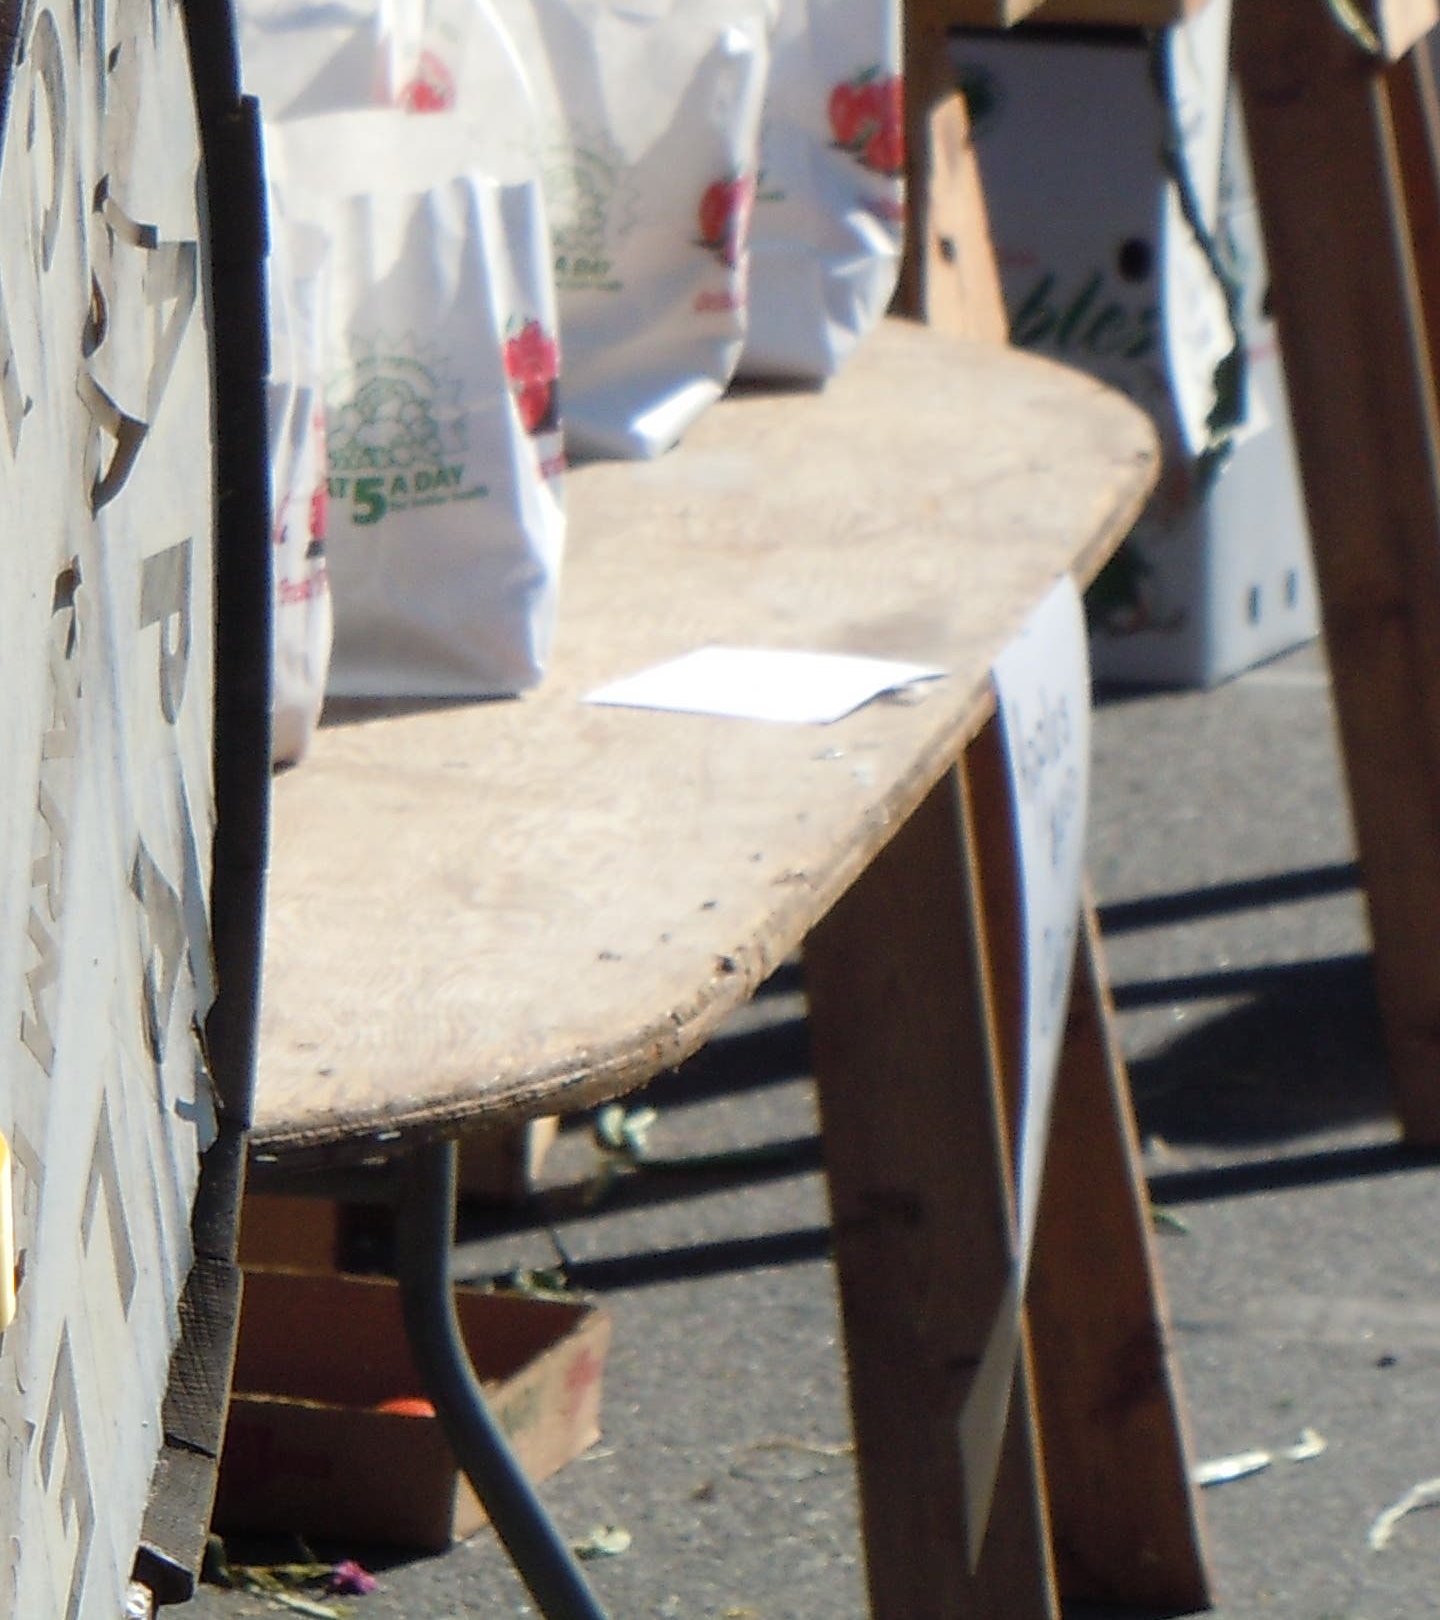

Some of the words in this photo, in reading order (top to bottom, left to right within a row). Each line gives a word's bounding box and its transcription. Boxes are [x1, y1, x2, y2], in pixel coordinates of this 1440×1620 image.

[352, 476, 388, 525] 5
[391, 475, 408, 495] A
[415, 464, 464, 492] DAY
